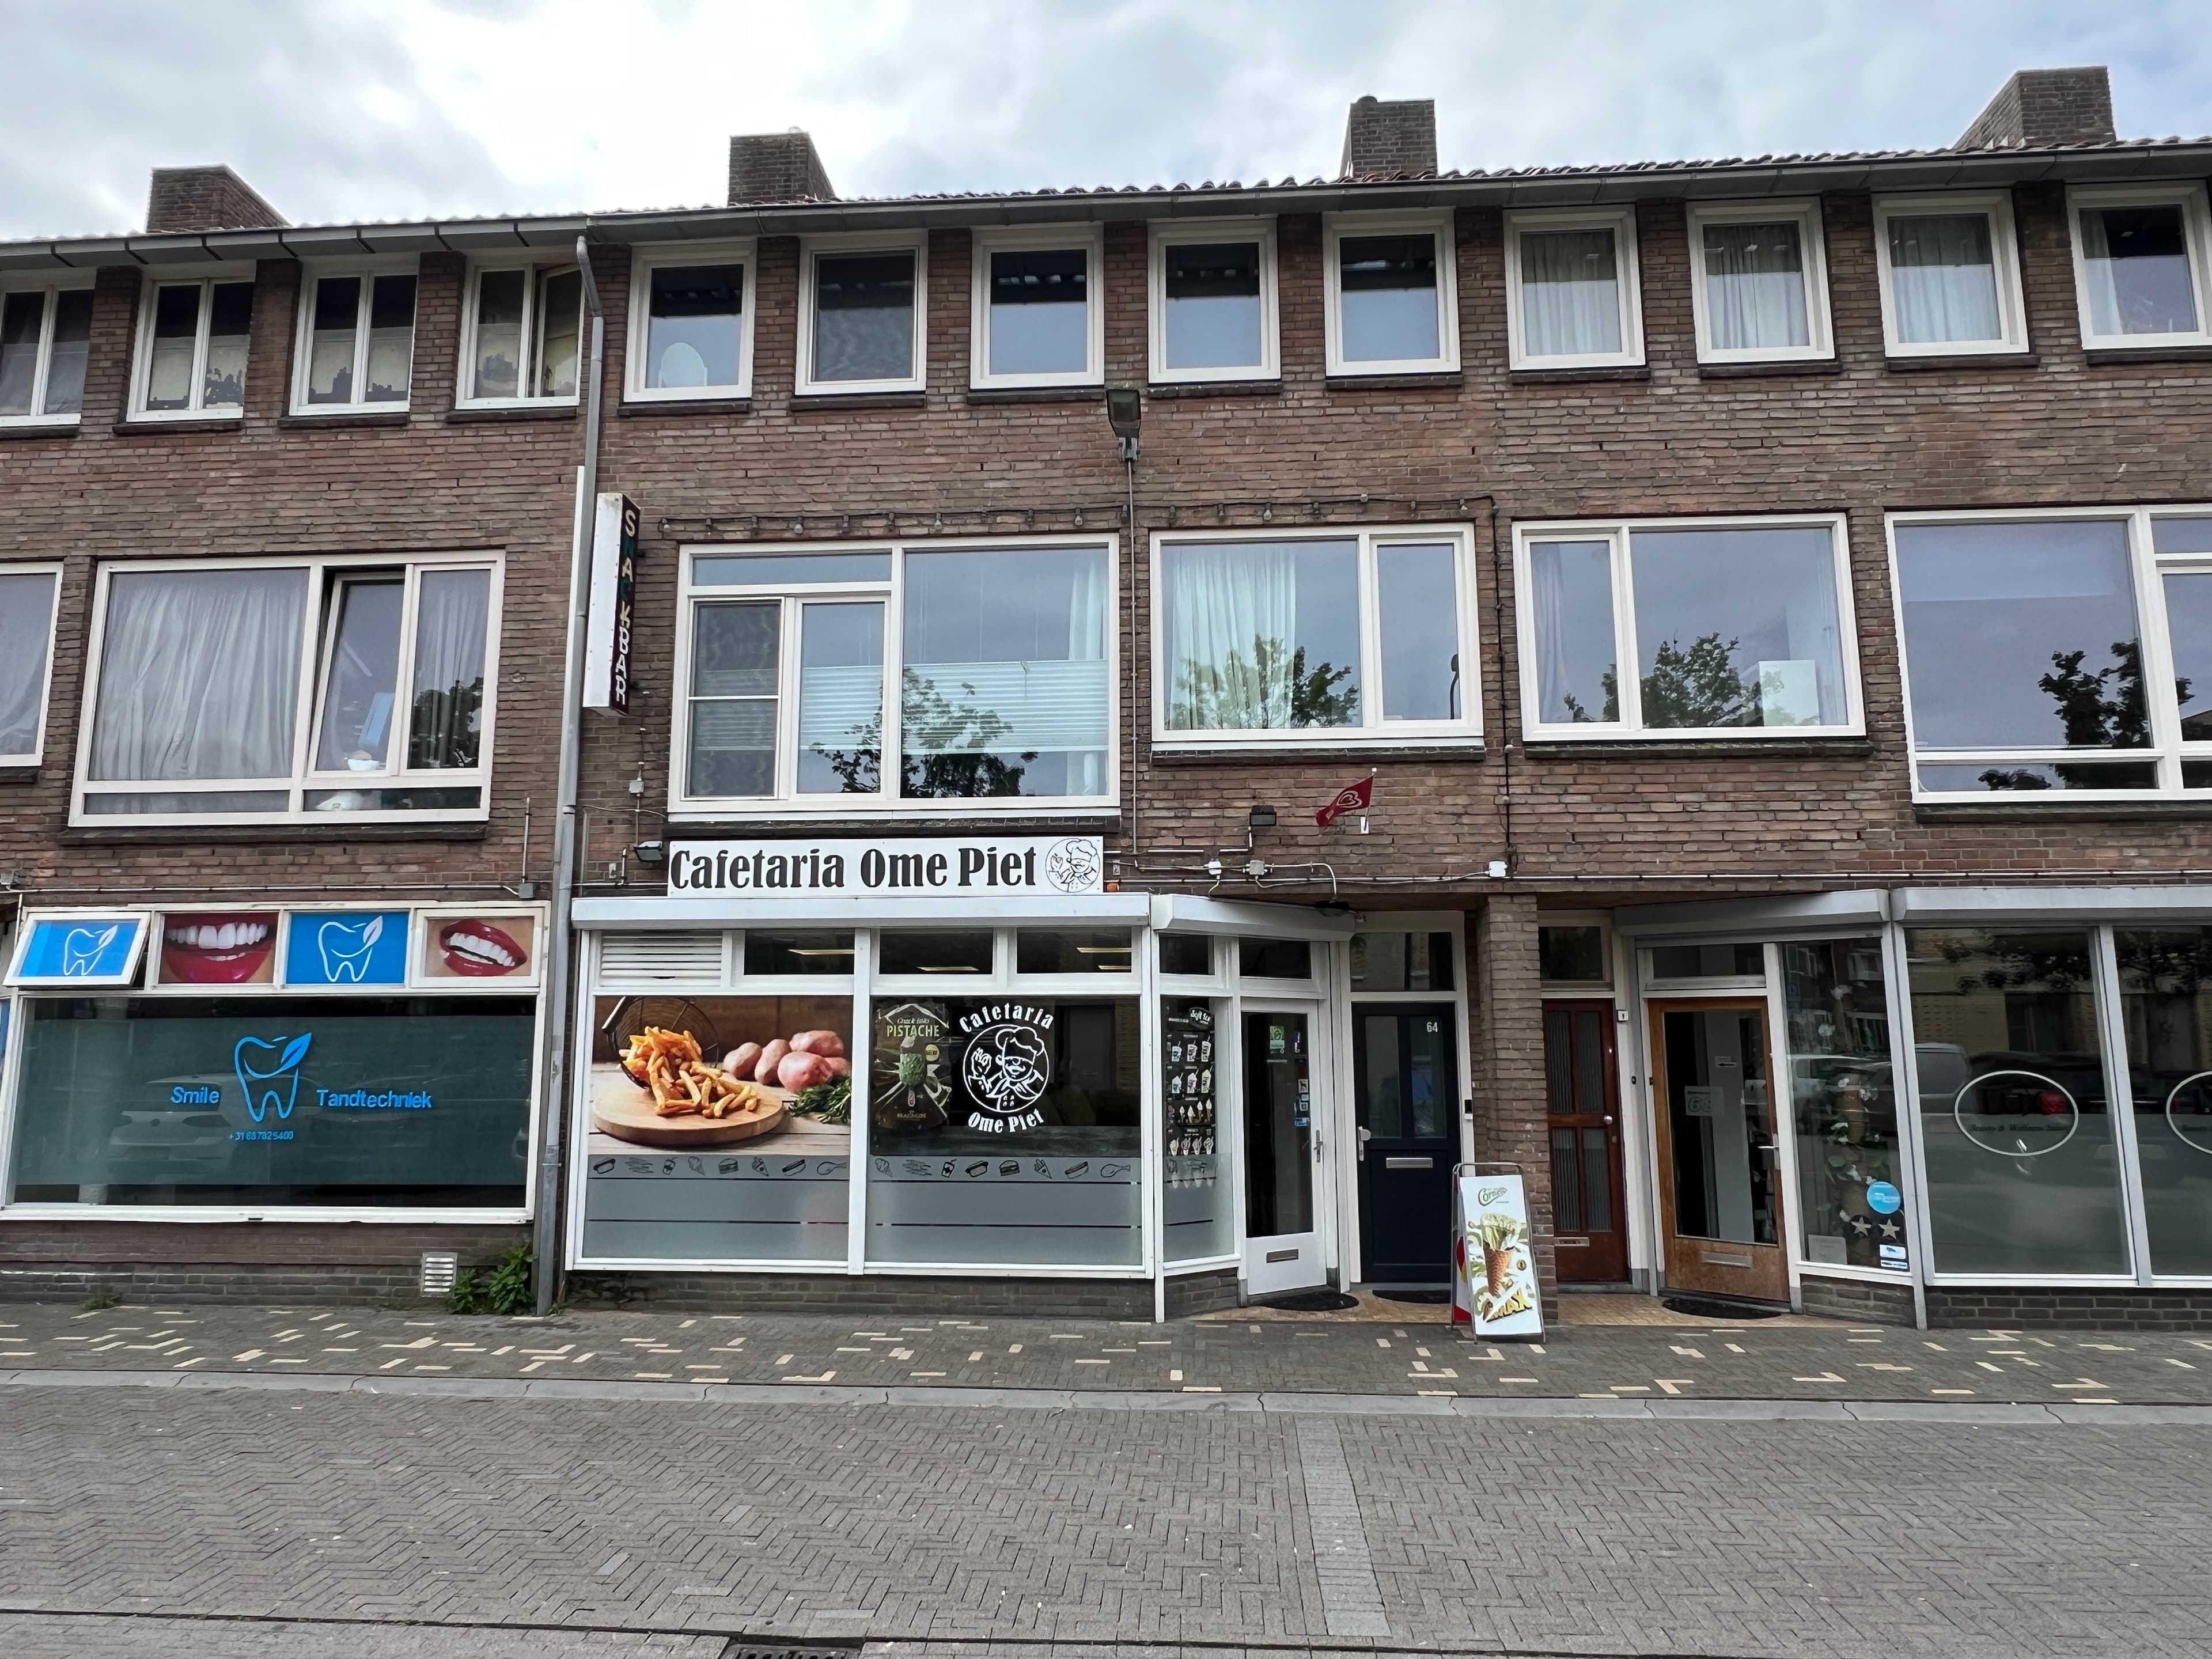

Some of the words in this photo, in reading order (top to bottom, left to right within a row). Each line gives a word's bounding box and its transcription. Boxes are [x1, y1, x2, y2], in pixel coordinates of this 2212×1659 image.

[670, 849, 845, 890] Cafetaria
[860, 849, 947, 888] Ome
[957, 846, 1036, 887] Piet
[959, 1002, 1054, 1032] Cafetaria
[1426, 1022, 1438, 1032] 64
[887, 1025, 940, 1037] PISTACHE
[171, 1086, 220, 1104] Smile
[316, 1089, 432, 1108] Tandtechniek
[968, 1112, 1003, 1133] Ome
[1007, 1108, 1044, 1132] Piet
